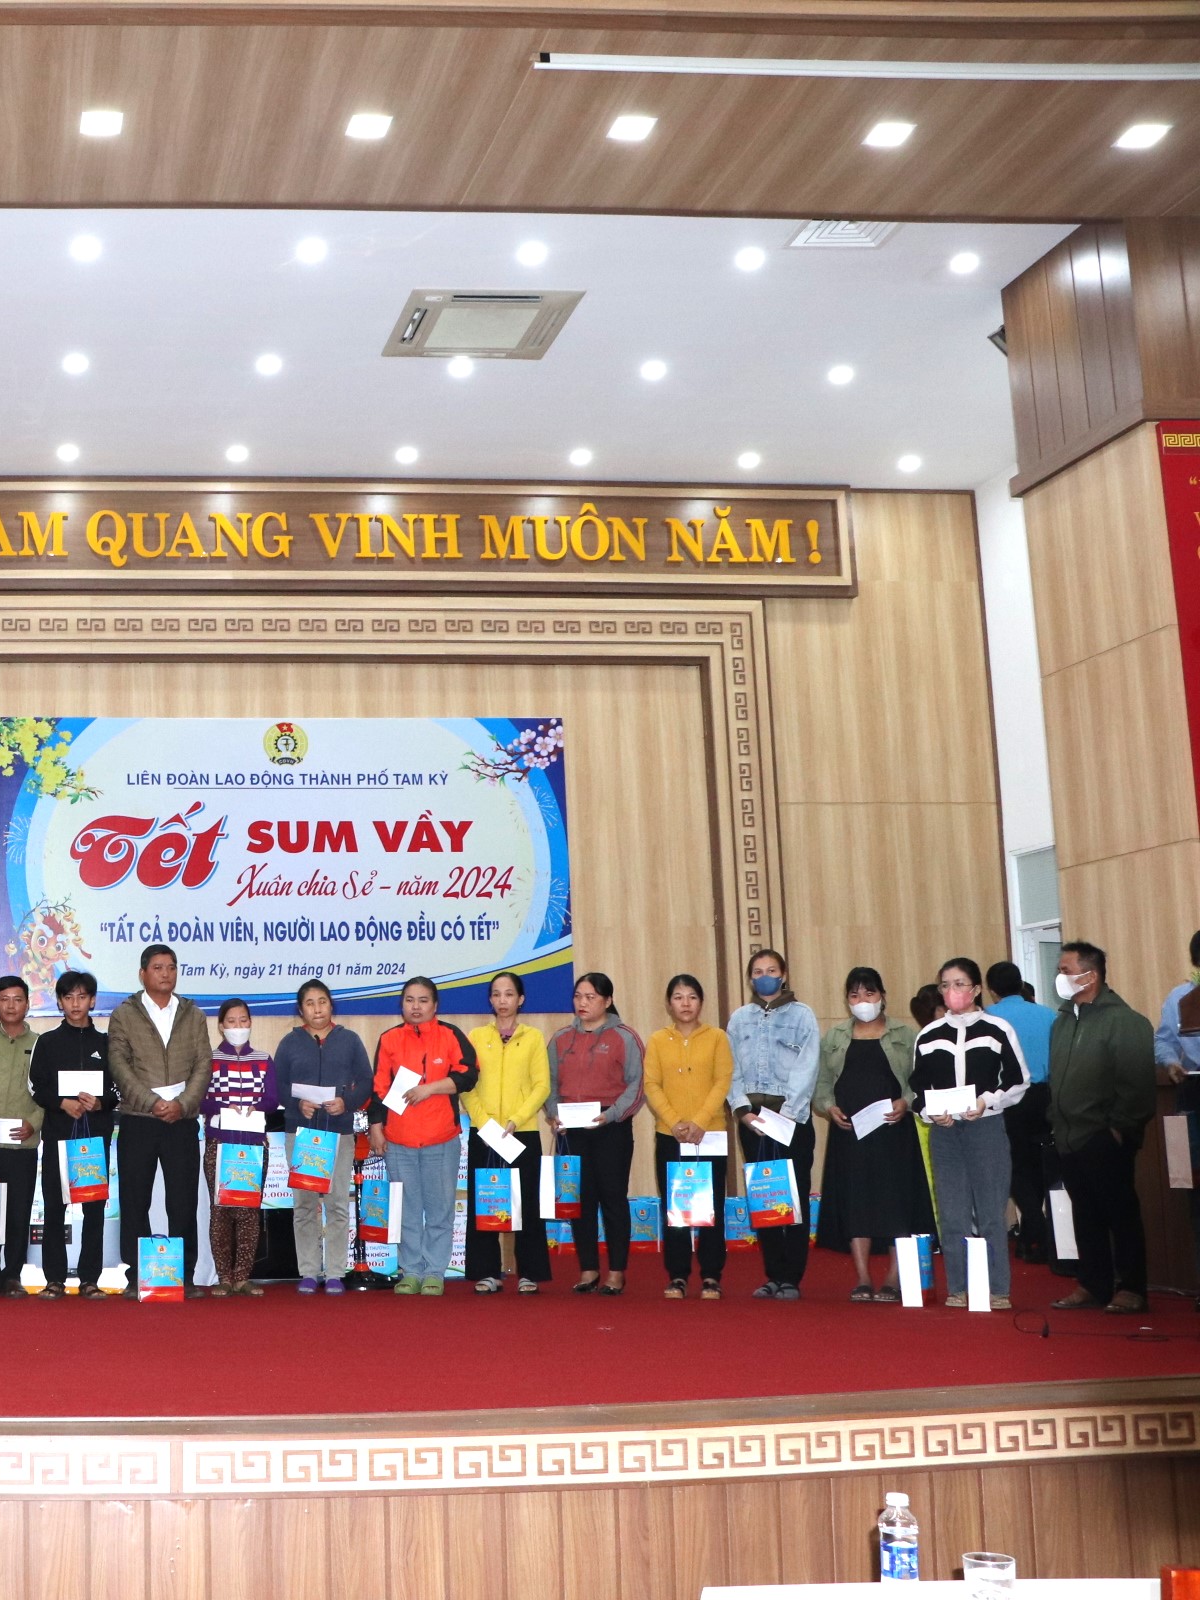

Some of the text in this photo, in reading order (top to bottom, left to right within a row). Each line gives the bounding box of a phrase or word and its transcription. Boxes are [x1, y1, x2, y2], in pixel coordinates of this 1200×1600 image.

[86, 510, 292, 567] QUANG
[309, 513, 463, 559] VINH
[480, 502, 648, 561] MUÔN
[666, 506, 796, 563] NĂM
[806, 520, 822, 564] !
[127, 766, 449, 789] LIÊN ĐOÀN LAO ĐỘNG THÀNH PHỐ TAM KỲ
[70, 801, 228, 890] Tết
[247, 809, 474, 854] SUM VẦY
[227, 863, 294, 907] Xuân
[297, 868, 338, 897] chia
[396, 876, 440, 897] năm
[442, 866, 515, 900] 2024
[100, 911, 500, 949] “TẤT CẢ ĐOÀN VIÊN, NGƯỜI LAO ĐỘNG ĐỀU CÓ TẾT”
[181, 963, 406, 980] Tam Kỳ, ngày 21 tháng 01 năm 2024
